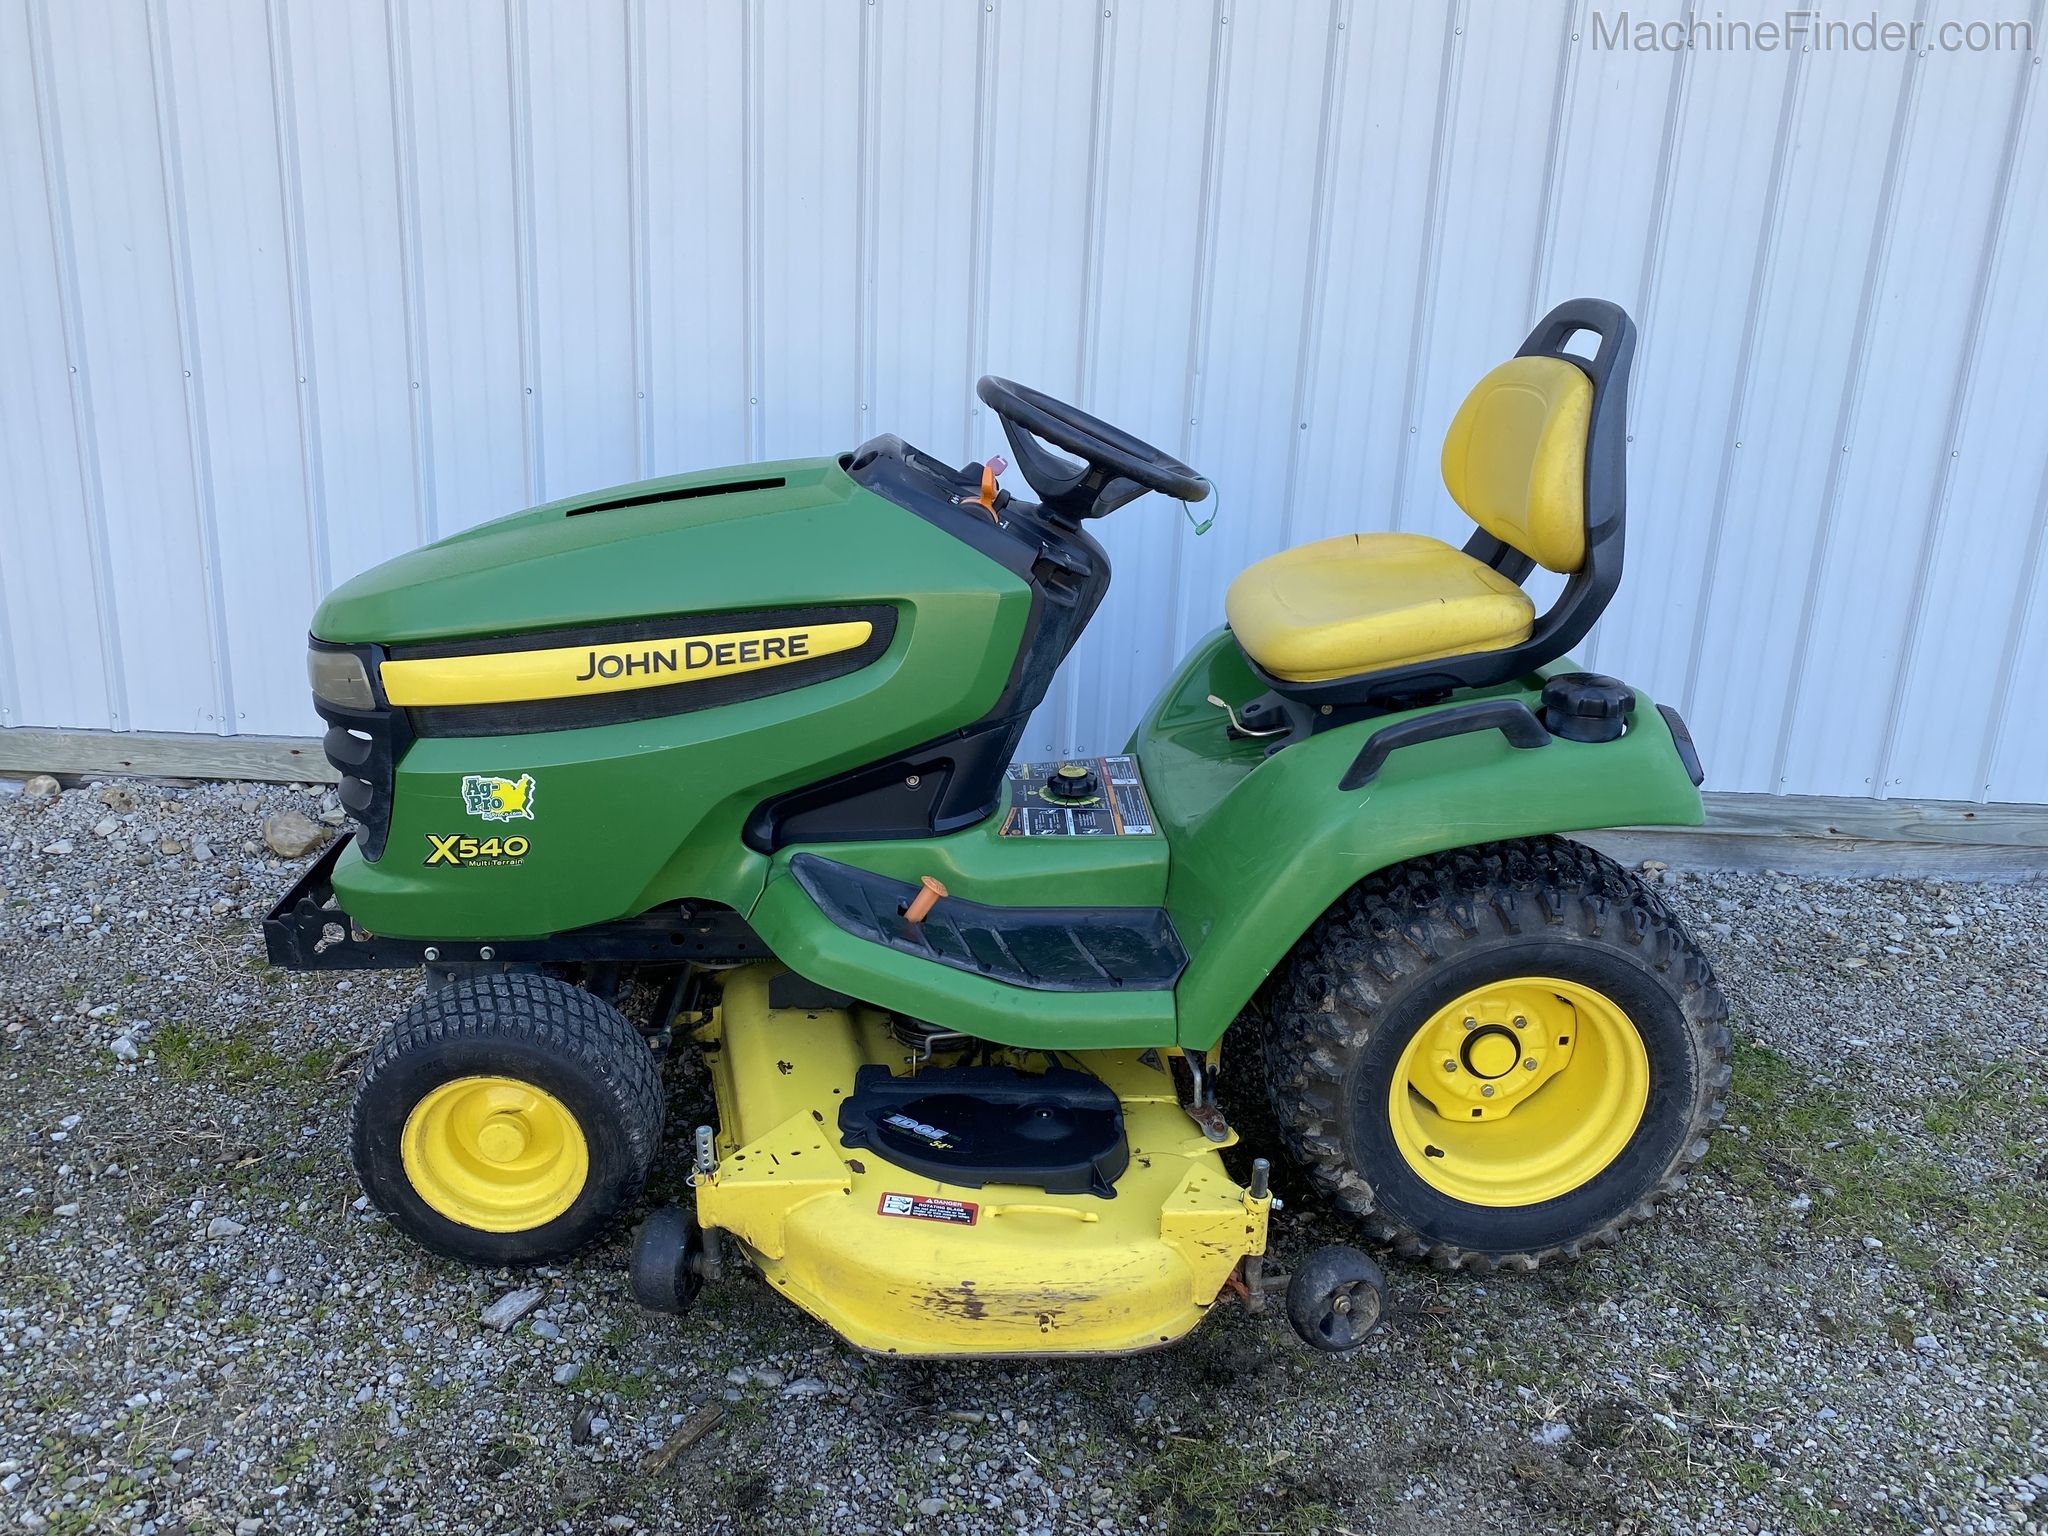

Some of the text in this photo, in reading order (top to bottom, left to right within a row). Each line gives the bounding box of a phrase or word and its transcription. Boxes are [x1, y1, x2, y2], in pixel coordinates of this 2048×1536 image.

[577, 634, 809, 681] JOHN DEERE
[466, 779, 499, 796] Ag-
[468, 796, 503, 812] Pro
[425, 834, 530, 865] X540
[934, 1199, 963, 1207] DANGER
